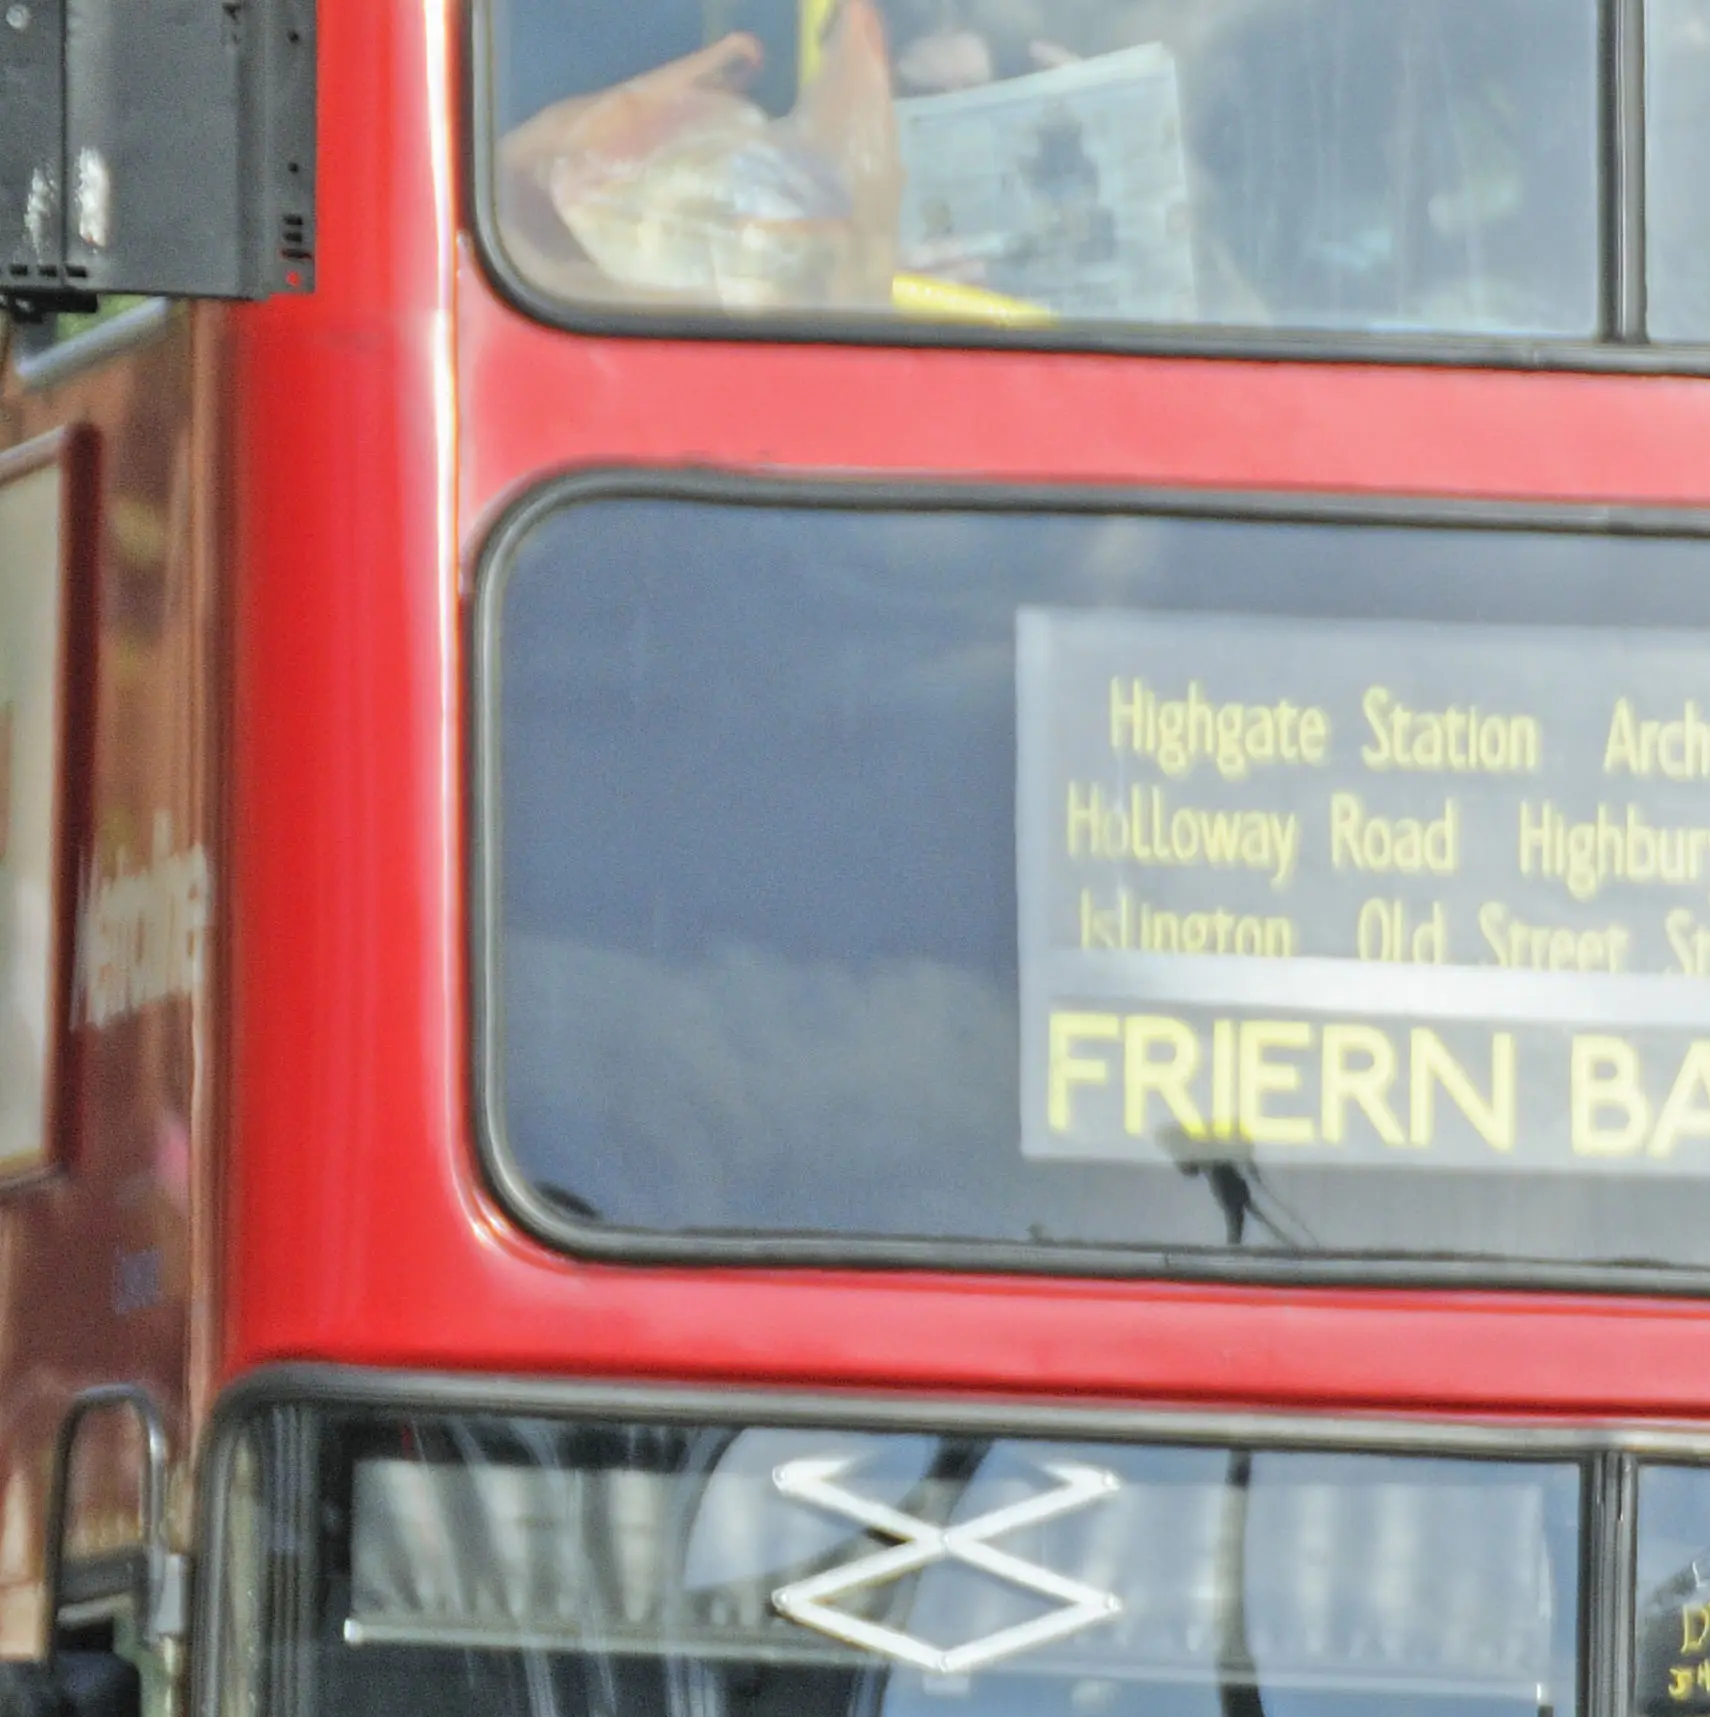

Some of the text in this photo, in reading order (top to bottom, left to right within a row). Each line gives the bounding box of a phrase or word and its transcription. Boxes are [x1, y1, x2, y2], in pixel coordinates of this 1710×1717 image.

[1110, 675, 1330, 780] Highgate
[1360, 684, 1540, 772] Station
[1066, 780, 1297, 894] Holloway
[1330, 792, 1458, 876] Road
[1357, 896, 1449, 966] Old
[1047, 1010, 1516, 1152] FRIERN
